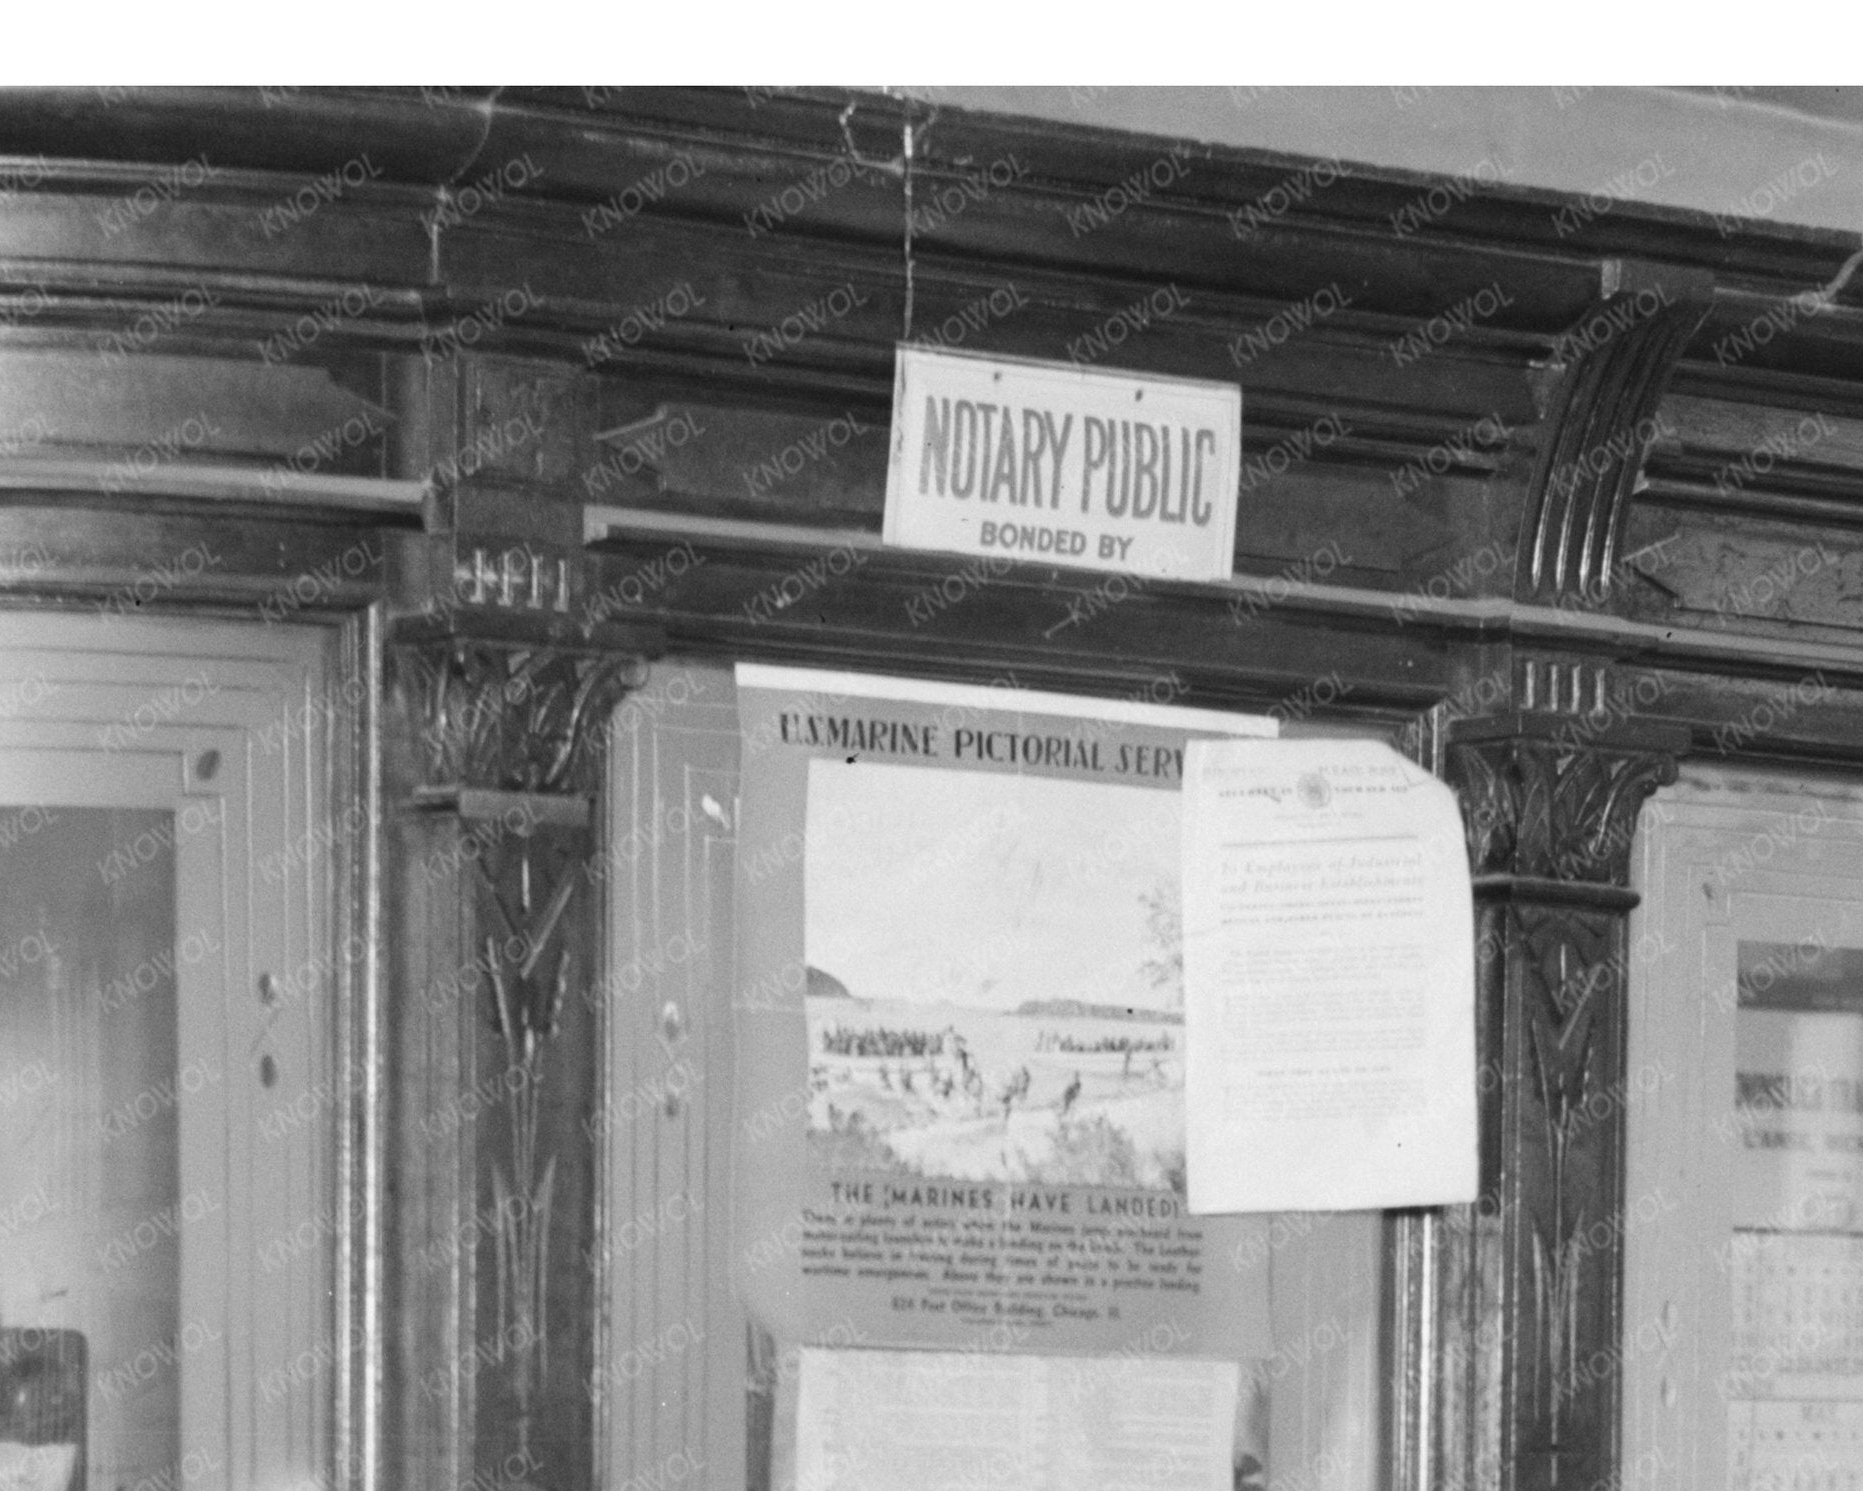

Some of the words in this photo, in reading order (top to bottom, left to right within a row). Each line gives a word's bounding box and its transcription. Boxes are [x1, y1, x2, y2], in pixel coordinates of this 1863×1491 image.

[918, 394, 1074, 510] NOTARY
[1081, 415, 1216, 528] PUBLIC
[979, 521, 1087, 557] BONDED
[1098, 534, 1135, 562] BY
[953, 728, 1105, 773] PICTORIAL
[831, 1180, 874, 1205] THE
[892, 1185, 994, 1210] MARINES
[1010, 1191, 1071, 1215] HAVE
